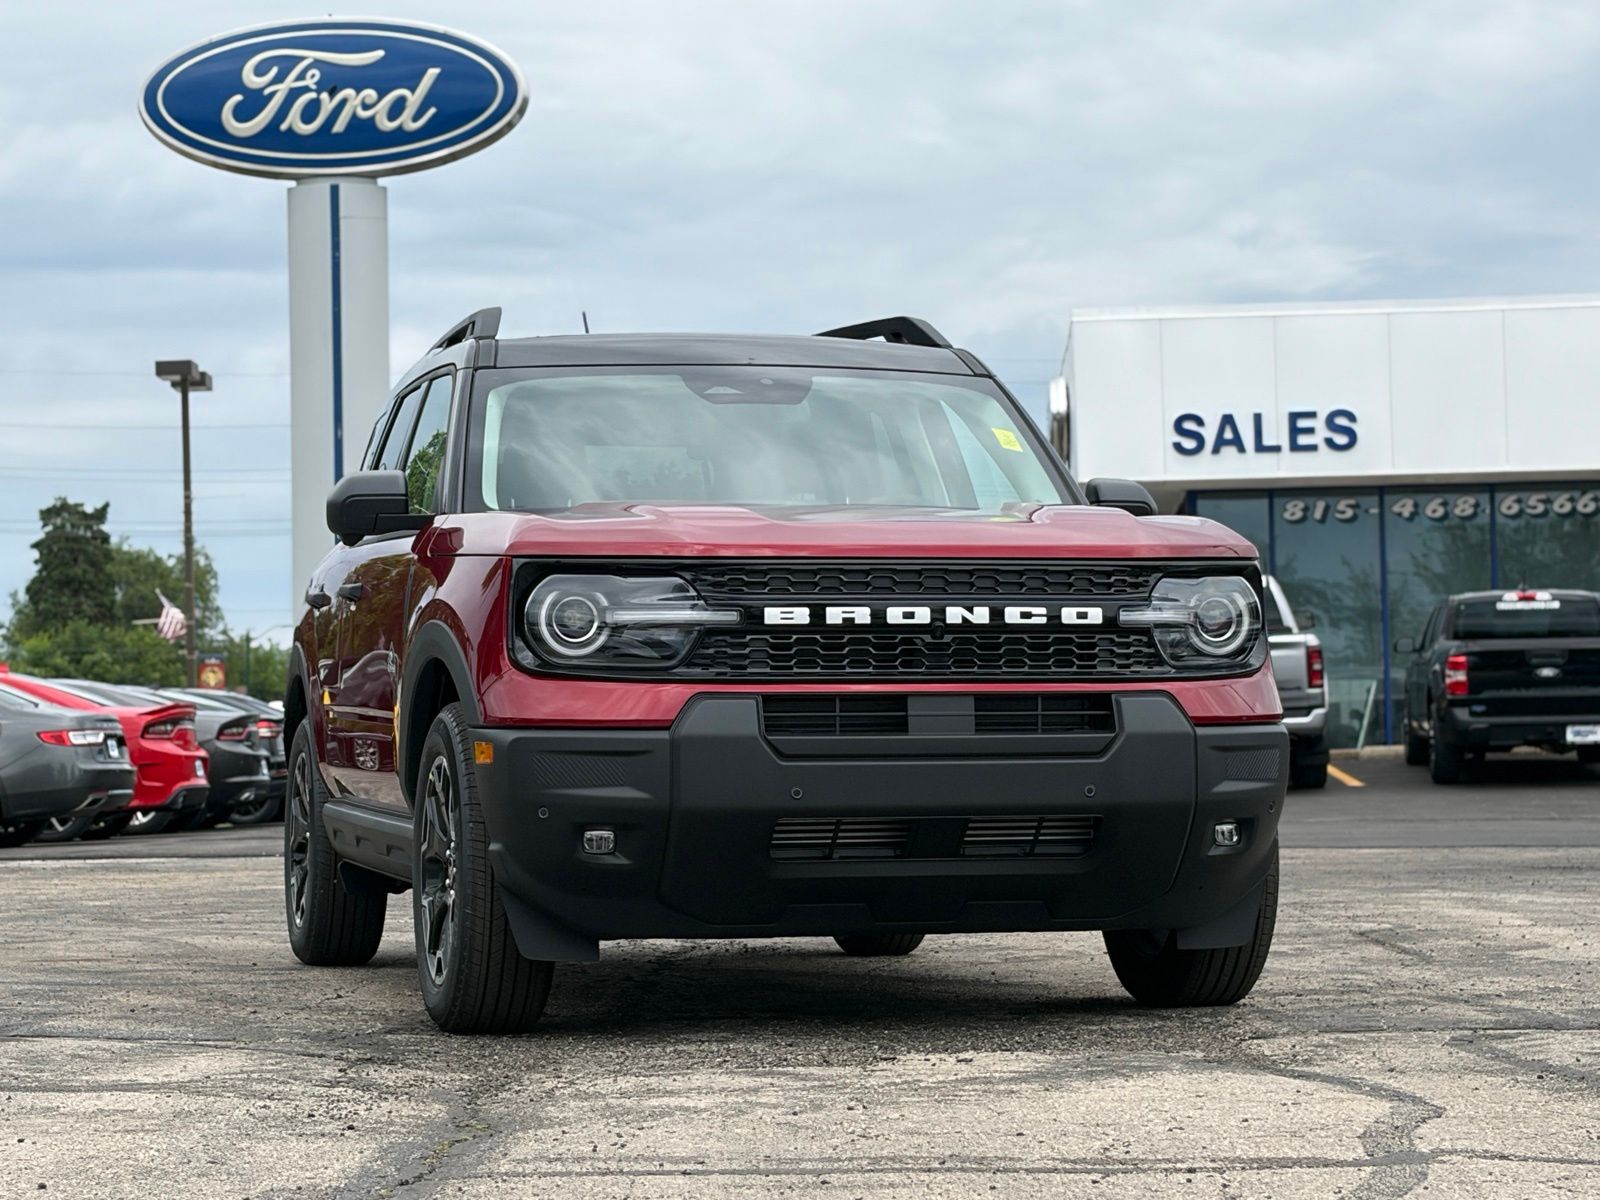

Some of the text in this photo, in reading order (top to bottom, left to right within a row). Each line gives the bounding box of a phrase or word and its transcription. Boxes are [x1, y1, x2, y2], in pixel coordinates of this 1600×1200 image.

[221, 48, 441, 138] Ford
[1172, 409, 1358, 457] SALES
[764, 606, 1103, 625] BRONCO
